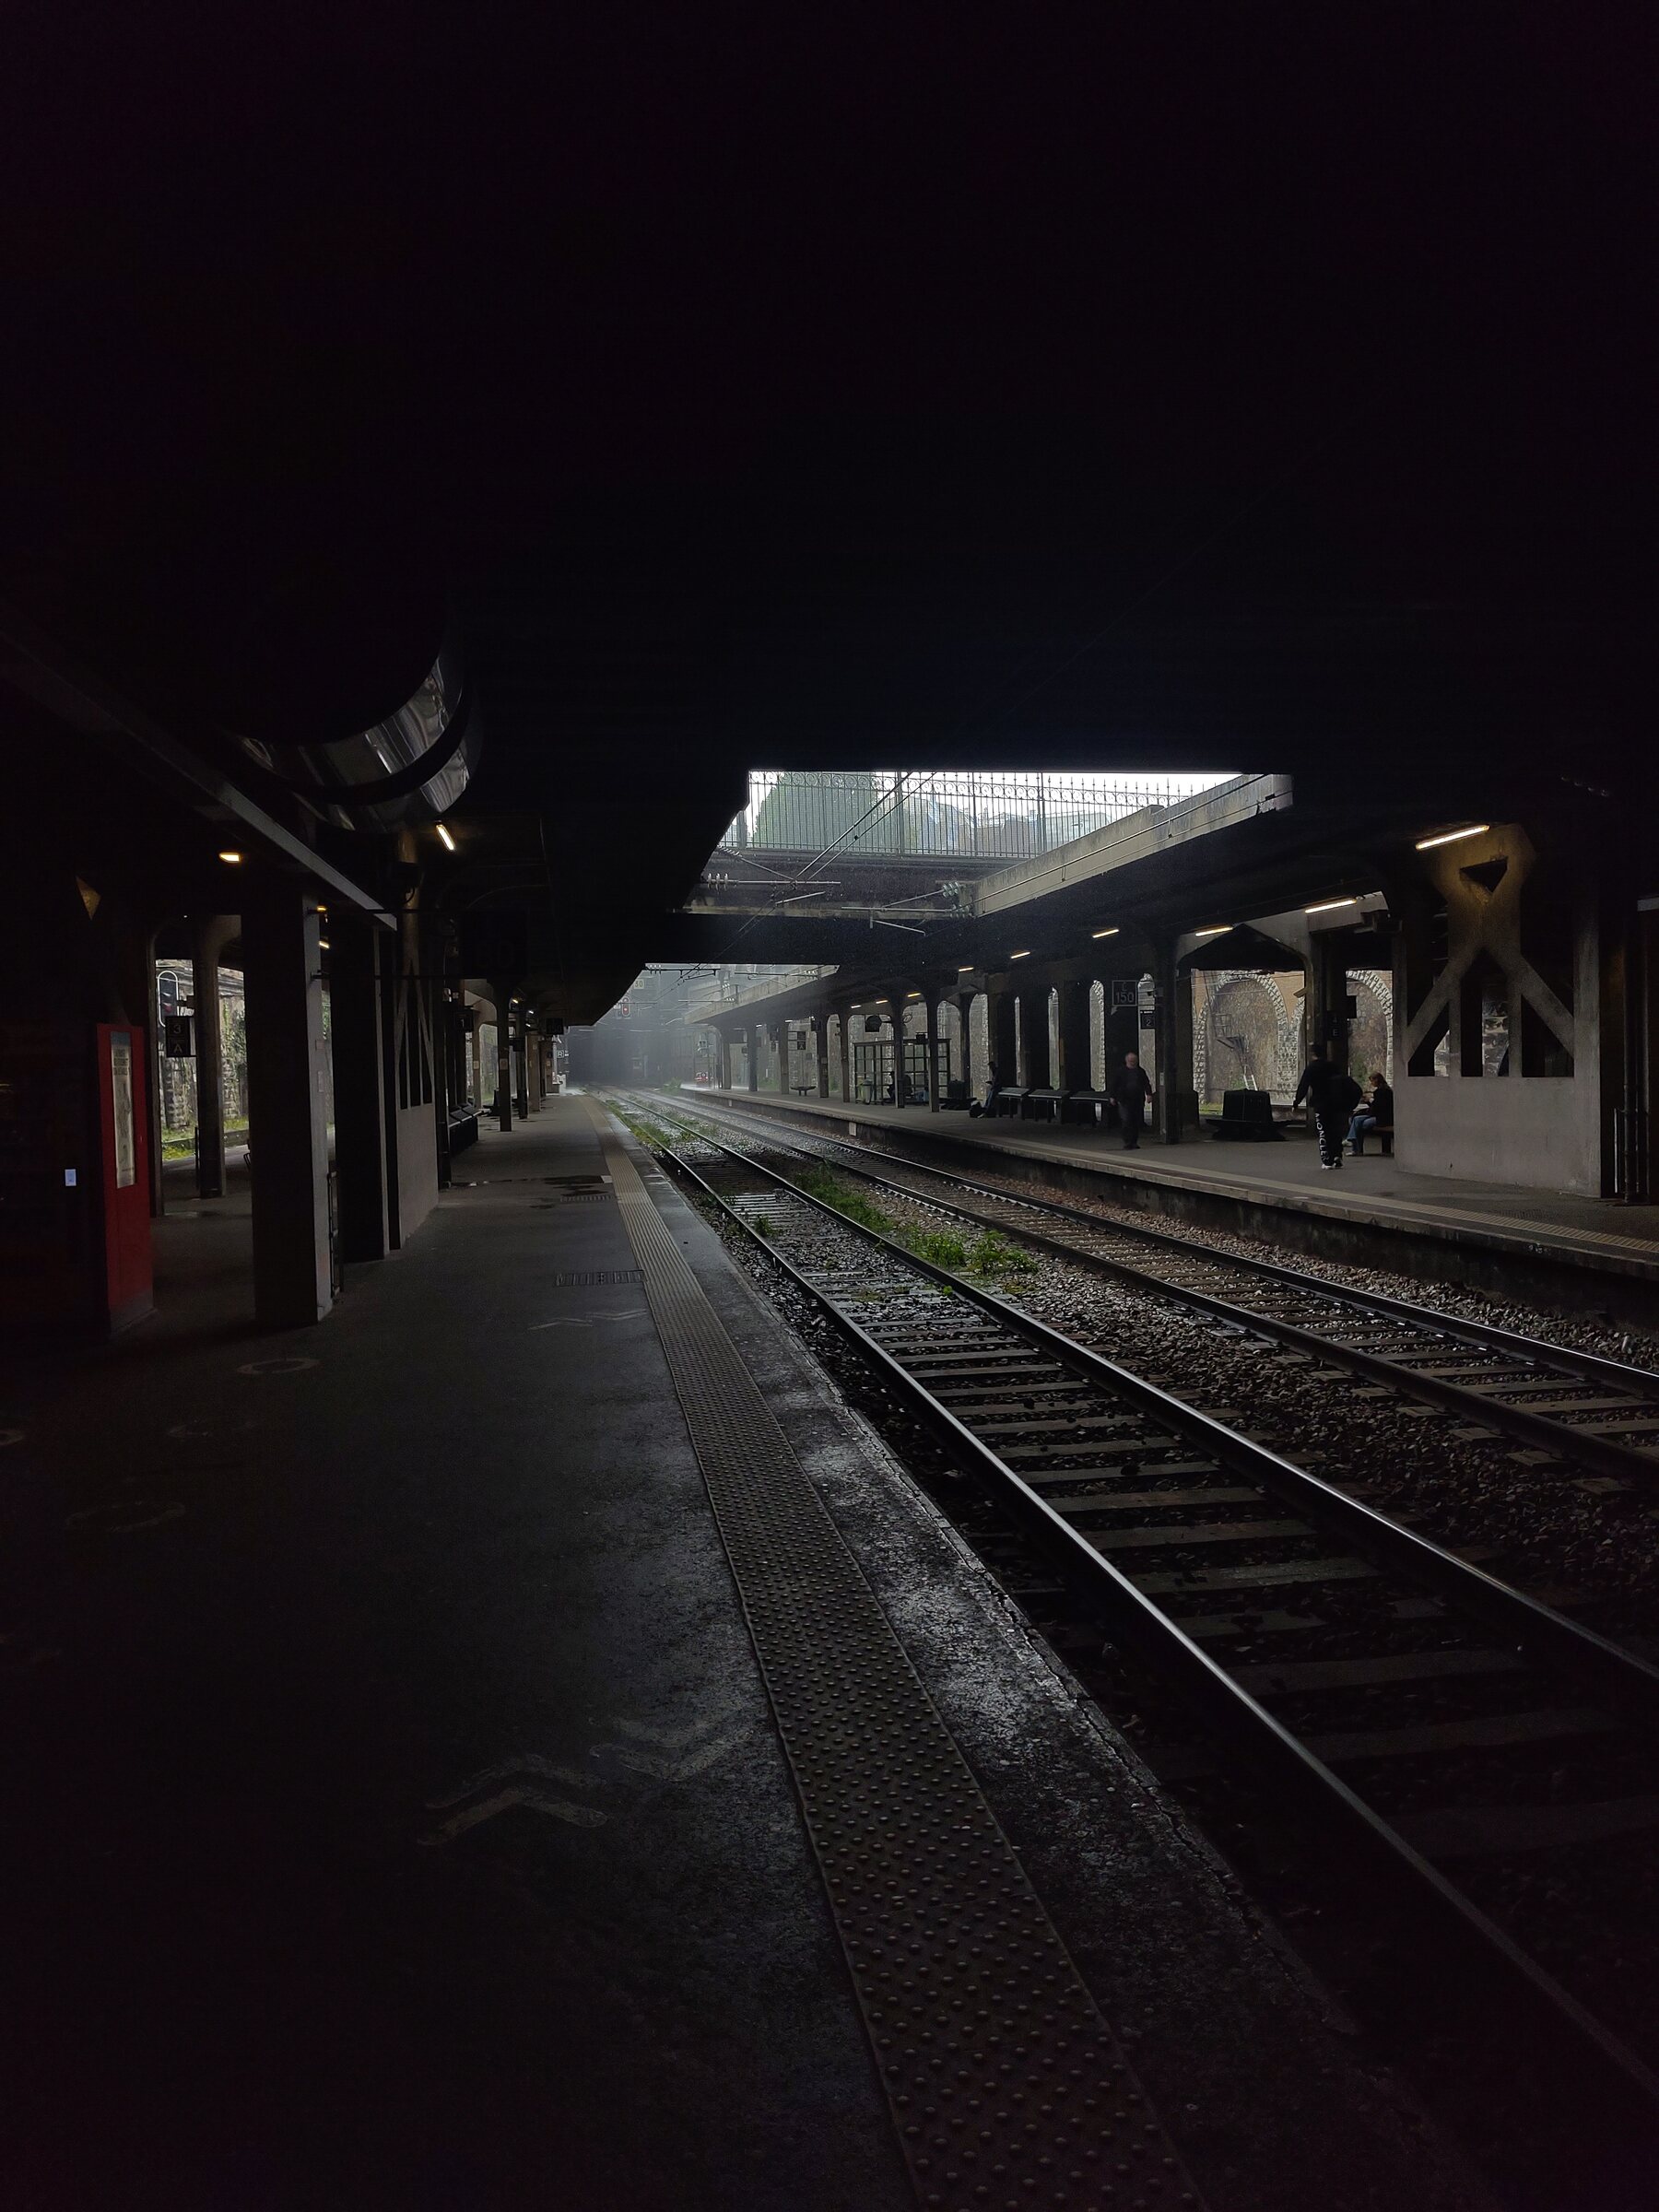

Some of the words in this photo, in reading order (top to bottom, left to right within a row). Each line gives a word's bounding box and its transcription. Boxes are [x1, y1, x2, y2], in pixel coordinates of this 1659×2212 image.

[1115, 992, 1135, 1004] 150
[173, 1024, 182, 1034] 3
[1333, 1028, 1339, 1037] E
[173, 1043, 182, 1053] A
[1315, 1112, 1330, 1161] MONCLER
